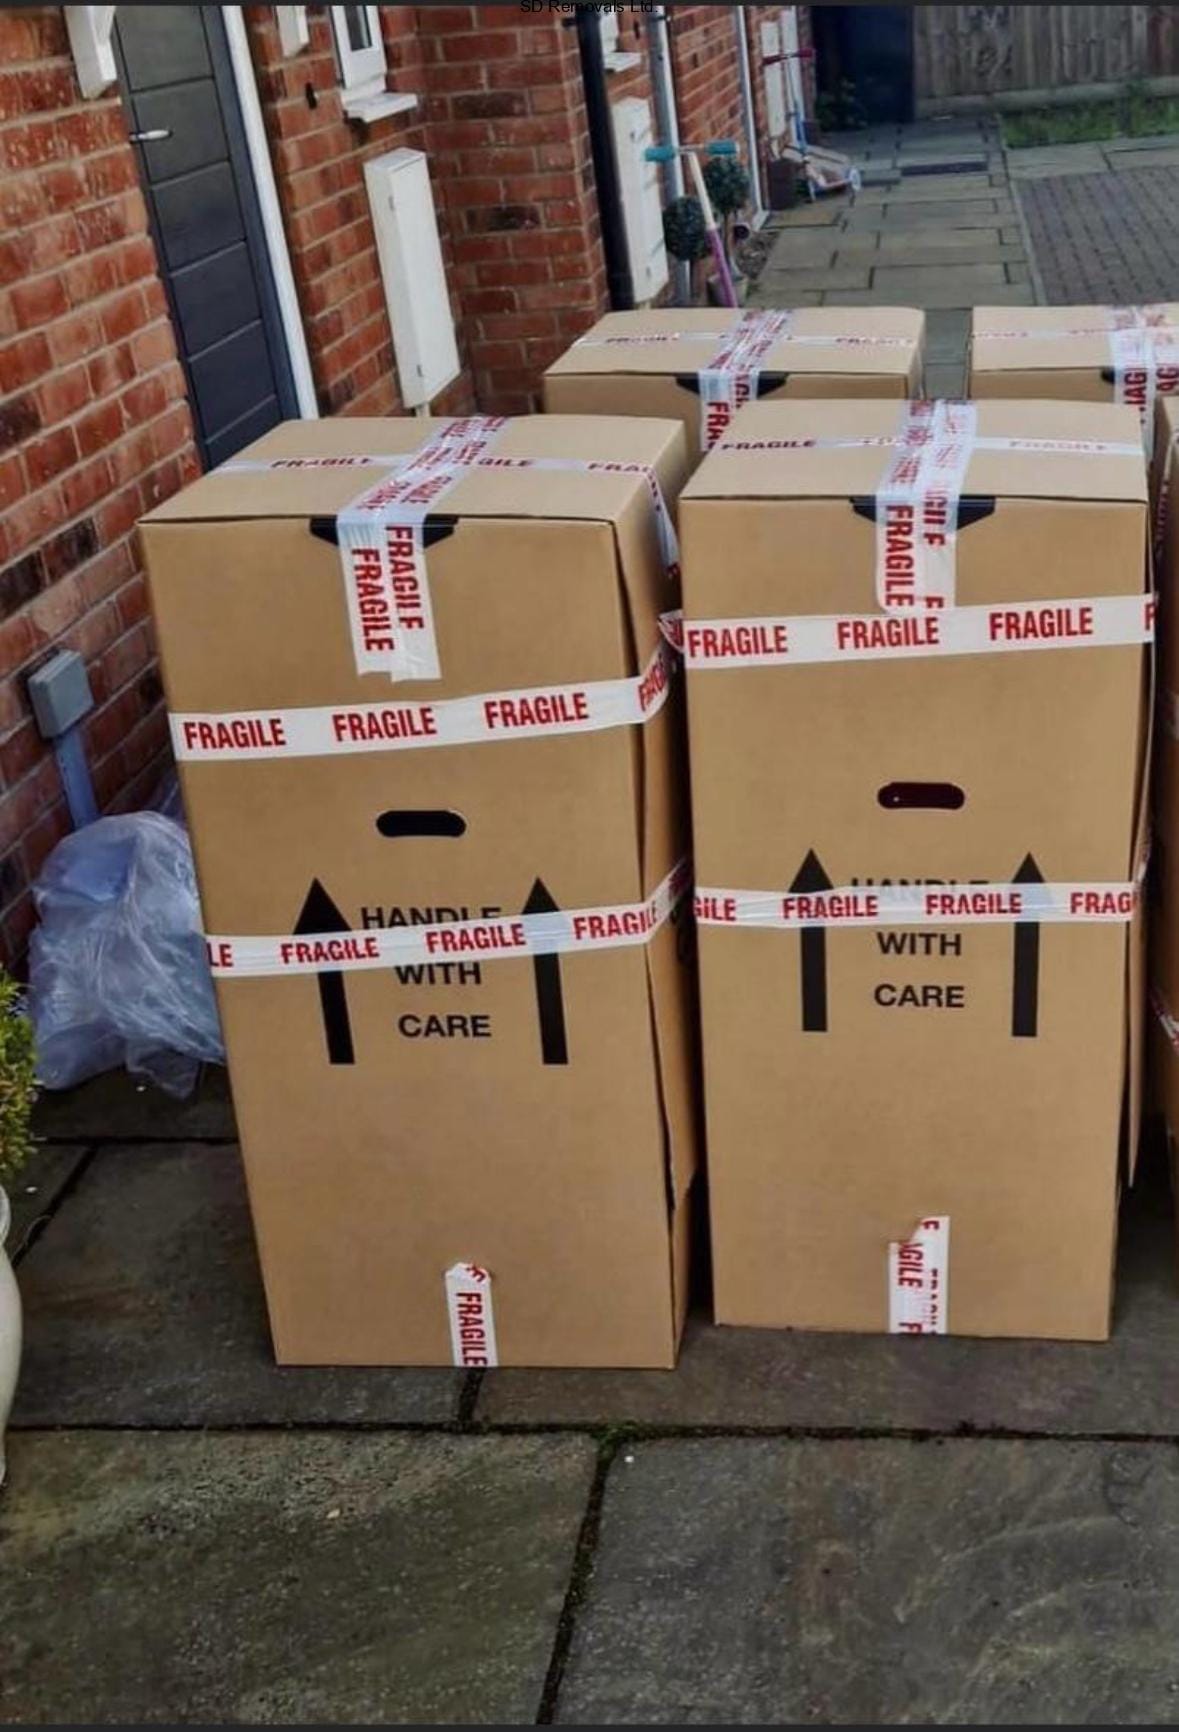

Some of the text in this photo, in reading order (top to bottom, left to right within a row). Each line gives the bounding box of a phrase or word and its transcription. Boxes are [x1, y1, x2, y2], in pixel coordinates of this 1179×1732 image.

[722, 441, 816, 450] FRAGILE
[885, 505, 915, 607] FRAGILE
[351, 548, 395, 651] FRAGILE
[687, 625, 788, 658] FRAGILE
[837, 616, 939, 650] FRAGILE
[988, 607, 1093, 641] FRAGILE
[183, 718, 287, 750] FRAGILE
[332, 707, 437, 743] FRAGILE
[484, 692, 589, 729] FRAGILE
[782, 895, 879, 919] FRAGILE
[925, 893, 1022, 915] FRAGILE
[280, 937, 380, 964] FRAGILE
[425, 923, 526, 954] FRAGILE
[877, 931, 962, 956] WITH
[394, 961, 481, 985] WITH
[874, 984, 965, 1008] CARE
[398, 1014, 492, 1038] CARE
[456, 1293, 488, 1366] FRAGILE
